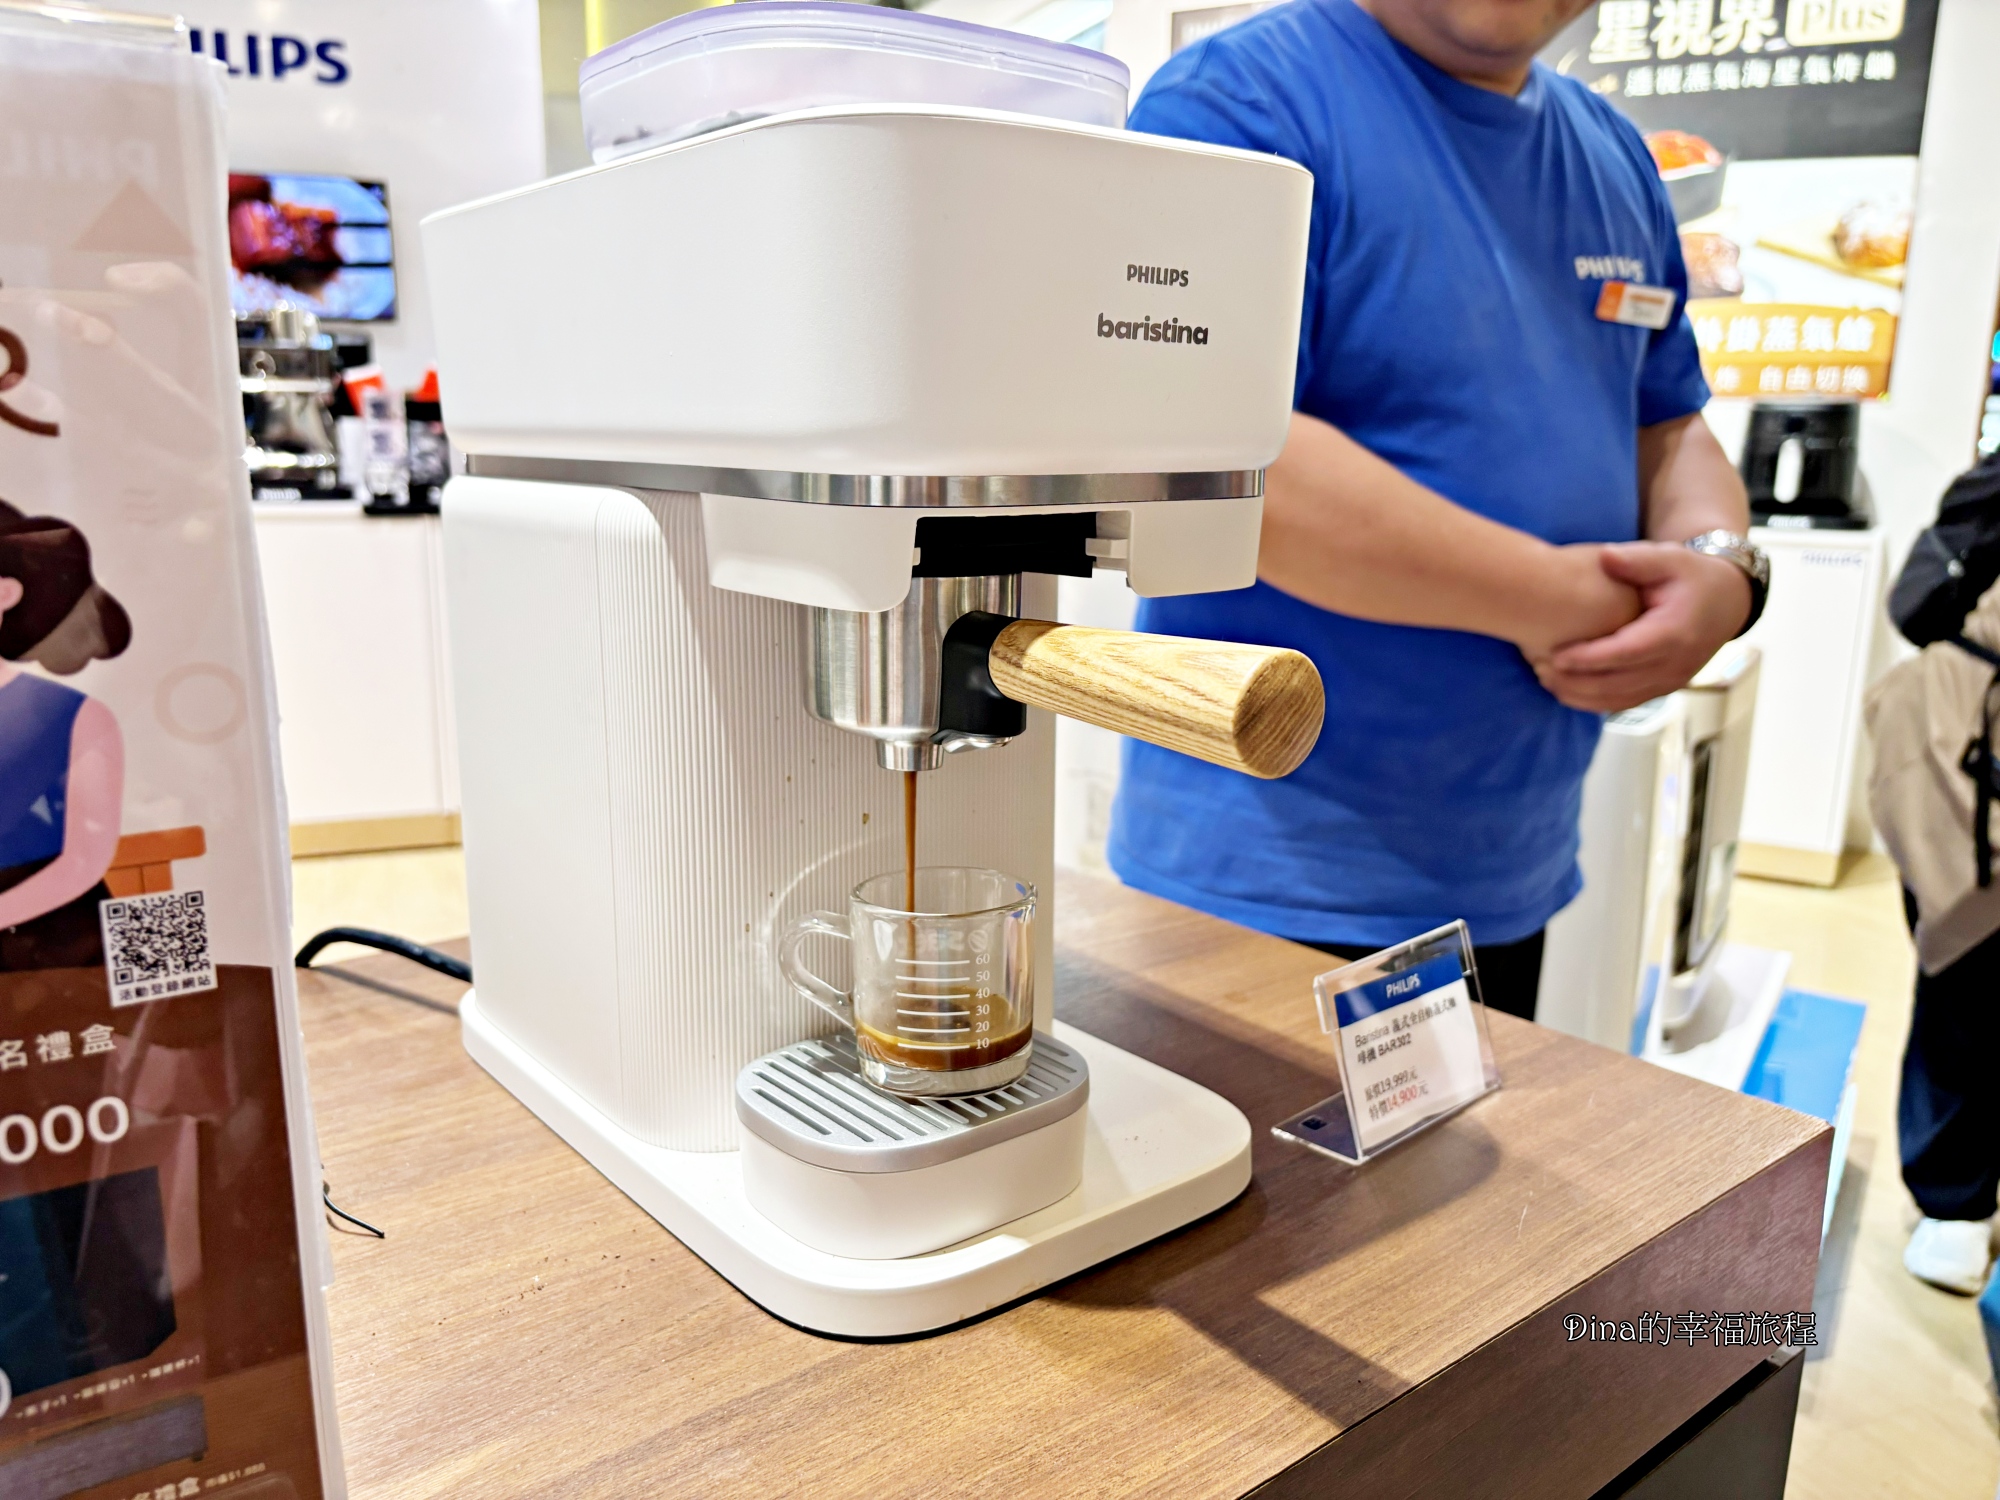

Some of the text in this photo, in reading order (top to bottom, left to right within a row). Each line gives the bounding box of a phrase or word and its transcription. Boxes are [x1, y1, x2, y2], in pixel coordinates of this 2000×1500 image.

[1588, 0, 1779, 64] 星視界
[1127, 264, 1189, 287] PHILIPS
[1097, 312, 1208, 345] baristina
[975, 953, 991, 965] 60
[975, 970, 991, 982] 50
[975, 987, 991, 999] 40
[1386, 973, 1421, 998] PHILIPS
[975, 1004, 991, 1016] 30
[975, 1021, 991, 1033] 20
[0, 1023, 117, 1072] 名禮盒
[975, 1038, 991, 1050] 10
[1378, 1032, 1412, 1056] BAR302
